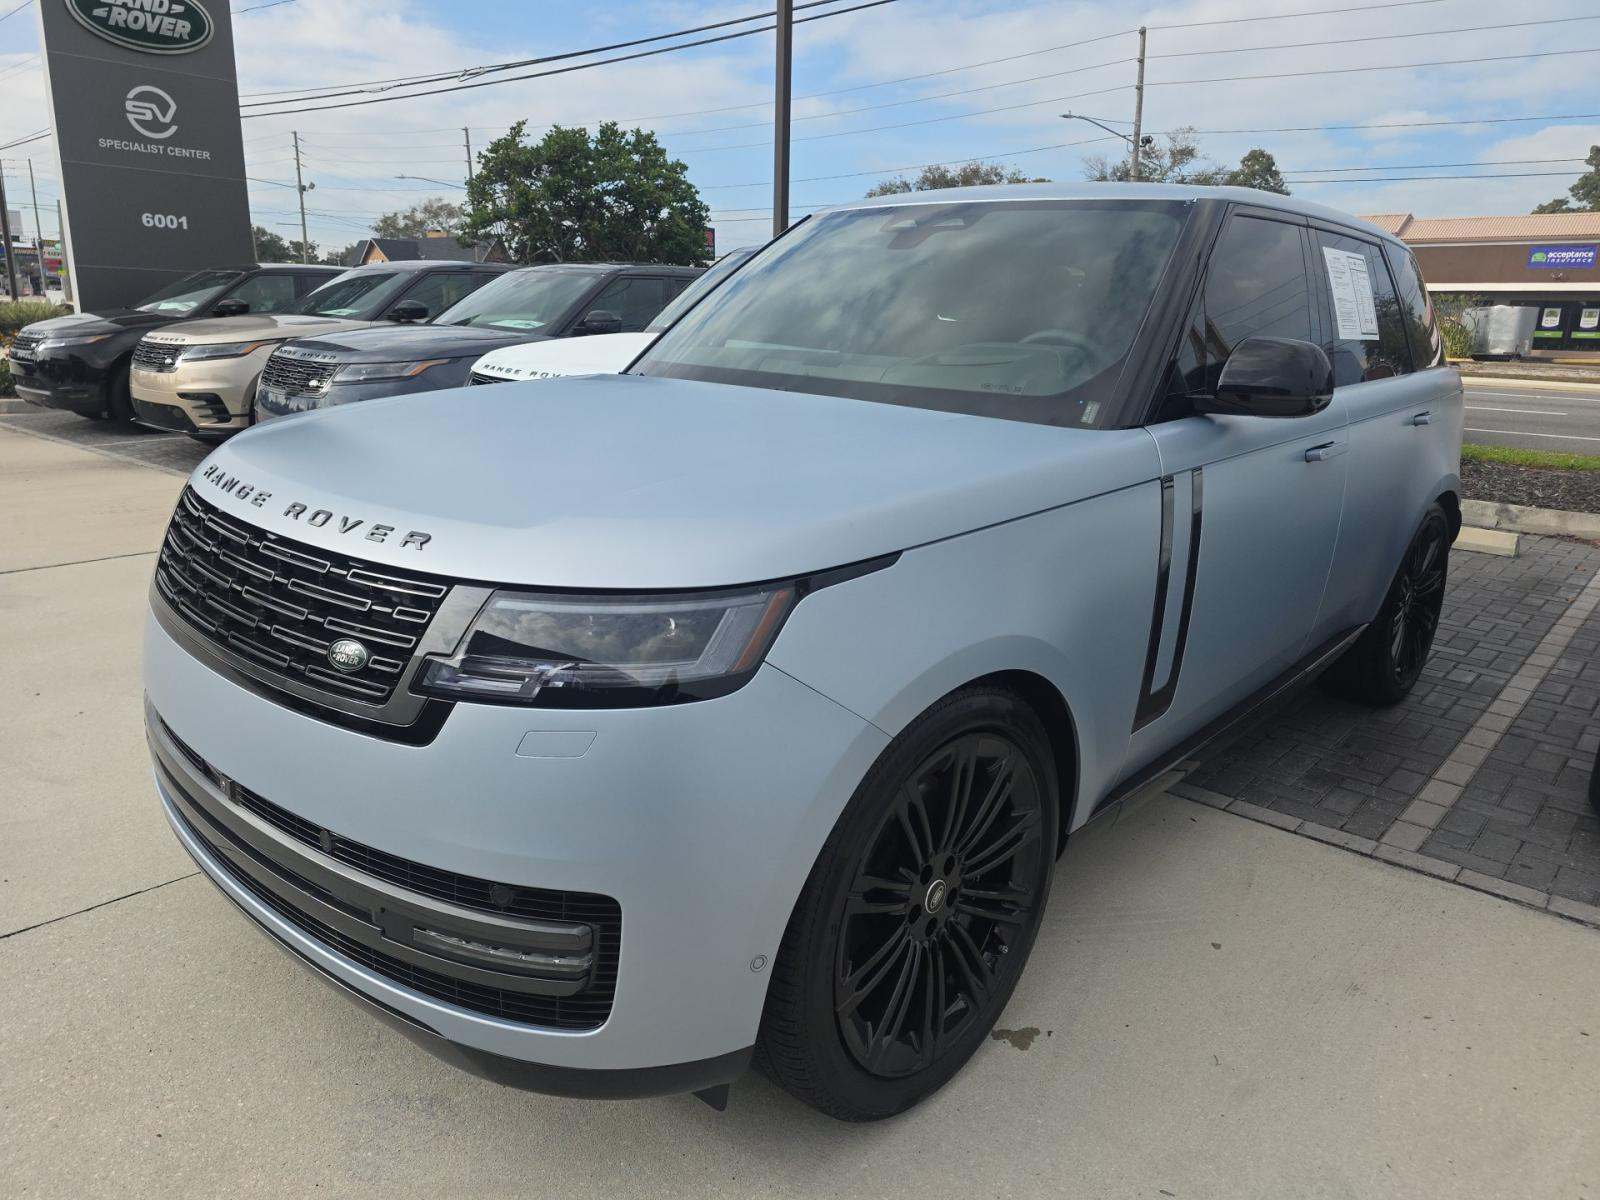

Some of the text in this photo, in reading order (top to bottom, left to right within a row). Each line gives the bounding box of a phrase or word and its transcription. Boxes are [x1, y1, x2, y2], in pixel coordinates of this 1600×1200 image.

[98, 0, 170, 14] ND
[107, 5, 191, 41] ROVER
[98, 138, 211, 160] SPECIALIST CENTER
[141, 212, 188, 230] 6001
[1547, 251, 1594, 260] acceptance
[483, 363, 523, 376] RANGE
[203, 463, 433, 551] RANGE ROVER
[334, 644, 357, 655] LAND
[335, 652, 359, 665] ROVER
